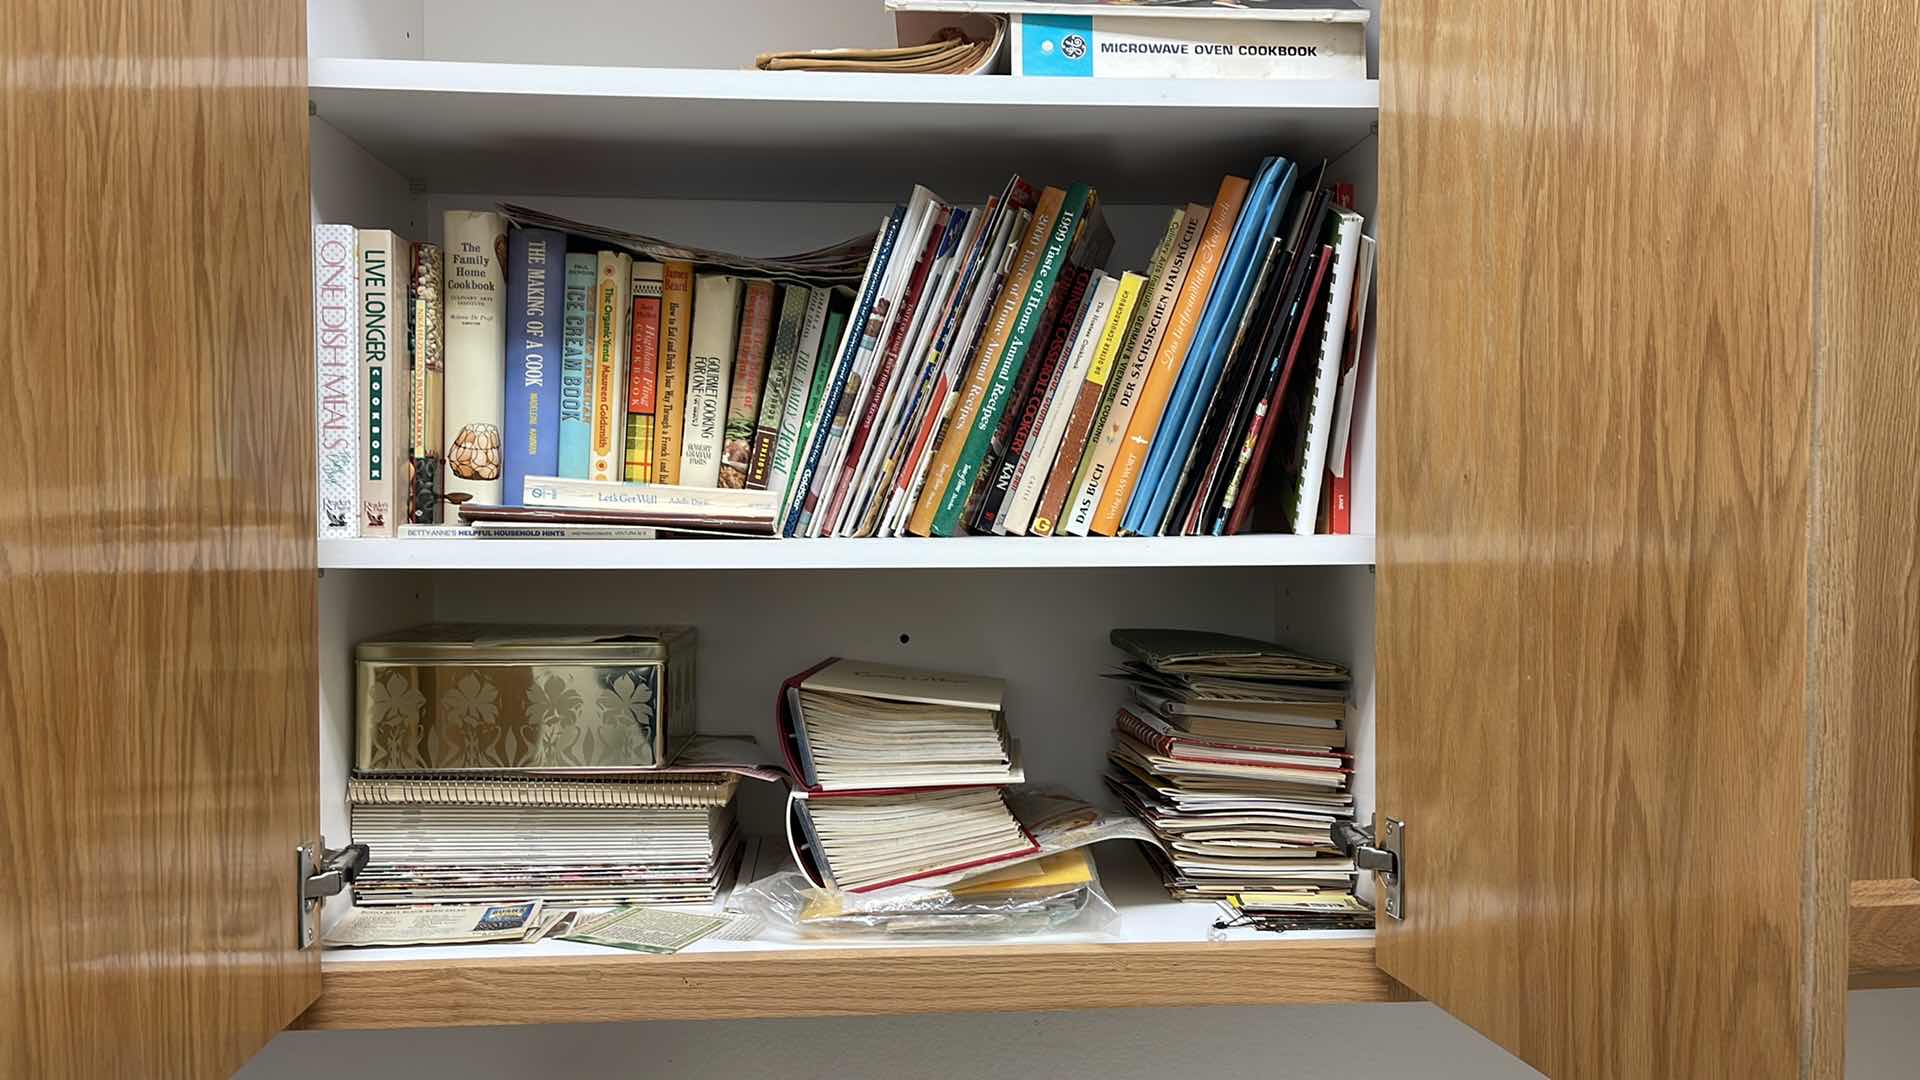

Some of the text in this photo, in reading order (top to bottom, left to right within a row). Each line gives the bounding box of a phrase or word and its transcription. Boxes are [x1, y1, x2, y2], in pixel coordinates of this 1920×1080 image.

[1100, 42, 1317, 57] MICROWAVE OVEN COOKBOOK
[453, 255, 489, 267] Family
[461, 242, 480, 252] The
[1015, 248, 1036, 281] Taste
[1141, 221, 1179, 308] Culinary Arts Institute
[320, 240, 346, 297] ONE
[448, 280, 495, 291] Cookbook
[456, 267, 486, 277] Home
[566, 286, 585, 311] ICE
[669, 303, 679, 316] How
[1007, 282, 1022, 299] of
[1060, 270, 1090, 326] CHINESE
[1095, 300, 1104, 312] The
[524, 240, 545, 386] THE MAKING OF A COOK
[975, 209, 1075, 432] 1999 Taste of Home Annual Recipes
[992, 297, 1016, 337] Home
[1120, 216, 1198, 407] DER SÄCHSISCHEN HAUSKÜCHE
[320, 306, 346, 366] DISH
[564, 316, 584, 371] CREAM
[642, 324, 654, 374] Highland
[1125, 315, 1144, 352] GERMAN
[365, 250, 385, 477] LIVE LONGER COOKBOOK
[599, 288, 613, 448] The Organic Yenta Maureen Goldsmith
[631, 323, 642, 406] COOKBOOK
[693, 356, 707, 375] FOR
[703, 357, 722, 398] GOURMET
[974, 338, 1000, 382] Annual
[1030, 324, 1069, 397] CASSEROLE
[561, 376, 581, 421] BOOK
[640, 376, 652, 407] Fling
[662, 390, 673, 403] Way
[665, 376, 674, 389] Your
[691, 375, 705, 393] ONE
[1106, 361, 1127, 403] VIENNESE
[321, 373, 348, 448] MEALS
[661, 404, 672, 428] Through
[771, 350, 810, 474] THE FAMILY Herbal
[952, 382, 982, 432] Recipes
[1008, 395, 1042, 455] COOKERY
[1092, 404, 1111, 444] COOKING
[660, 436, 670, 456] French
[791, 468, 813, 511] GoldStar
[995, 461, 1015, 491] KAN
[1075, 462, 1105, 524] DAS BUCH
